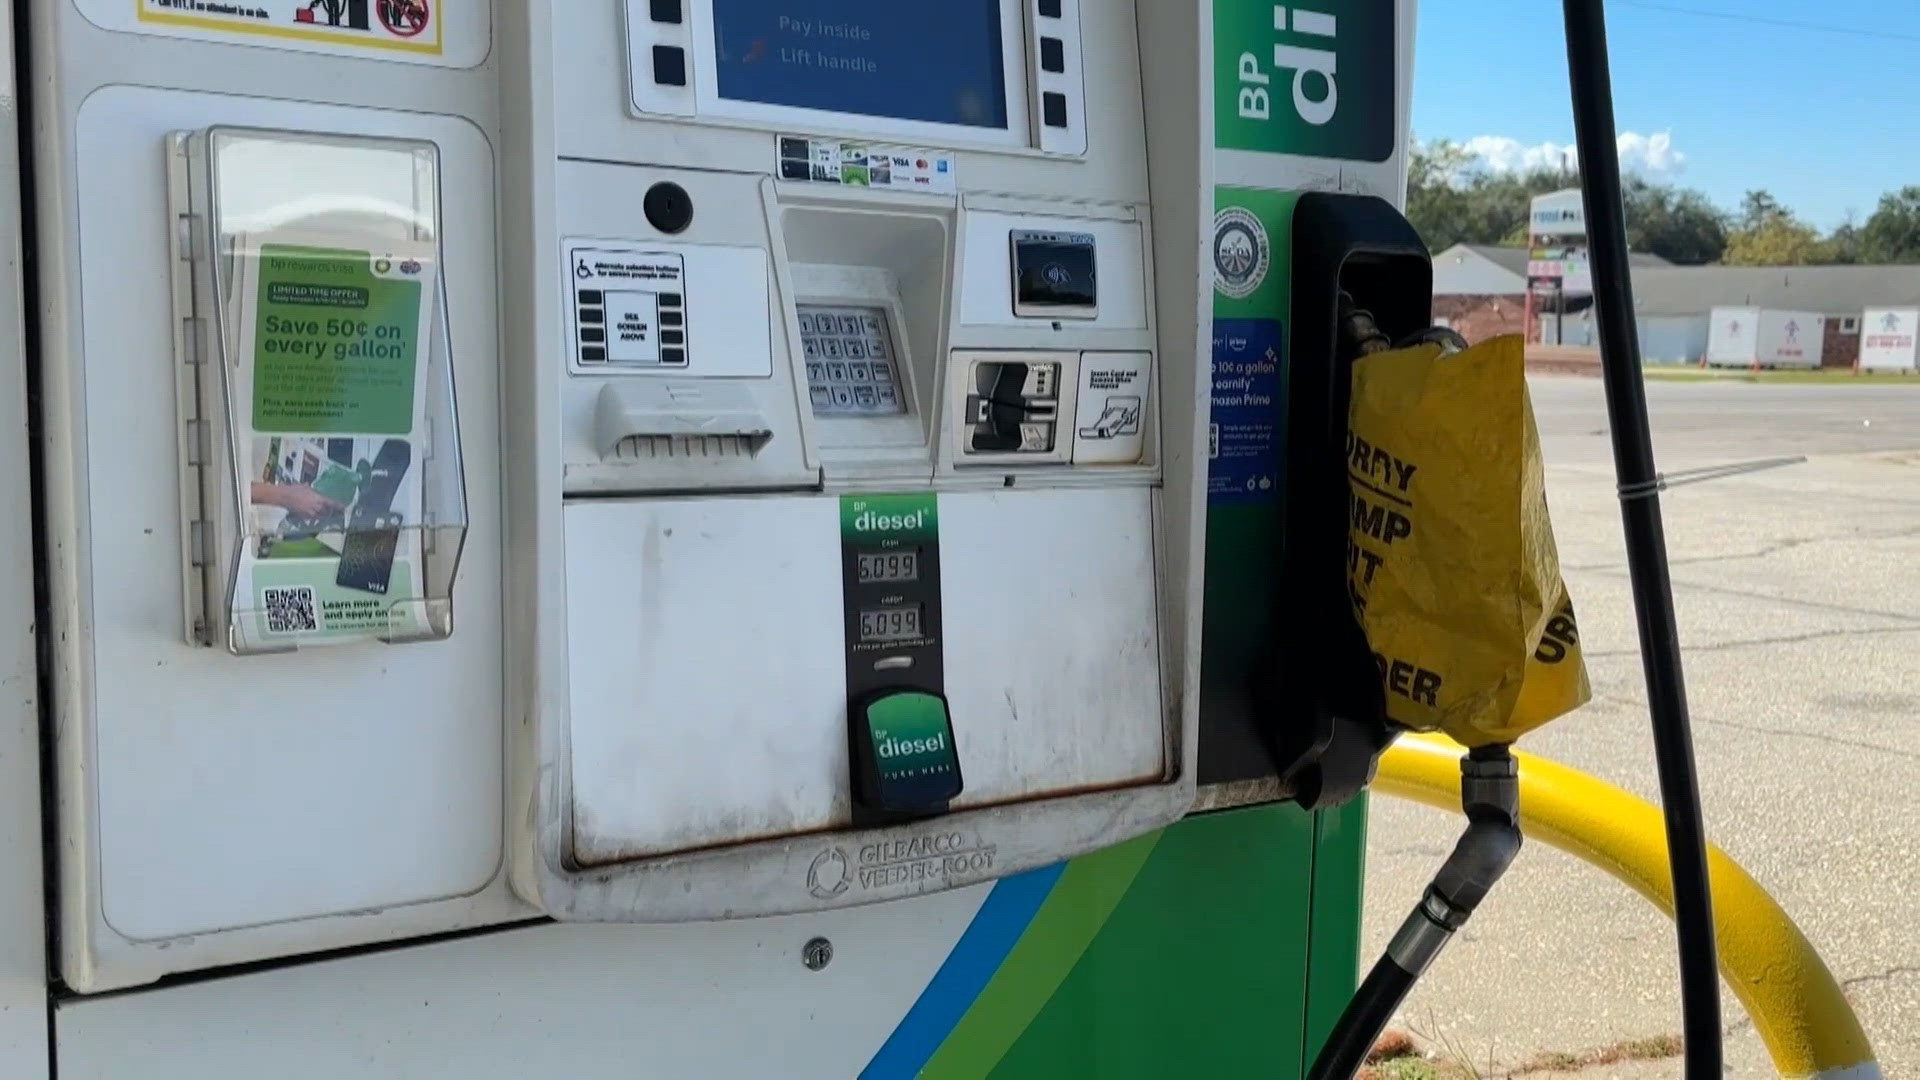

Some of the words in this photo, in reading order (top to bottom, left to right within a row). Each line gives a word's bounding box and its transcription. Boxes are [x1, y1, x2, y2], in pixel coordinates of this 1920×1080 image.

[779, 16, 811, 35] Pay
[781, 47, 811, 65] Lift
[818, 52, 877, 73] handle
[1238, 51, 1270, 120] BP
[273, 285, 307, 295] LIMITED
[309, 287, 329, 297] TIME
[330, 288, 359, 299] OFFER
[265, 315, 319, 335] Save
[326, 319, 368, 338] 50¢
[375, 324, 400, 339] on
[617, 323, 647, 331] SCREEN
[620, 332, 645, 341] ABOVE
[264, 339, 327, 360] every
[1245, 361, 1275, 376] gallon
[1211, 396, 1242, 406] mazon
[1244, 394, 1271, 407] Prime
[1349, 430, 1417, 492] RRY
[854, 501, 867, 512] BP
[881, 539, 899, 547] CASH
[859, 554, 914, 580] 6.099
[323, 600, 351, 610] Learn
[353, 600, 380, 609] more
[324, 611, 343, 620] and
[345, 609, 373, 620] apply
[861, 611, 916, 637] 6.099
[875, 729, 888, 740] BP
[879, 732, 946, 758] diesel
[859, 832, 963, 864] GILBARCO
[859, 850, 997, 890] VEEDER-ROOT
